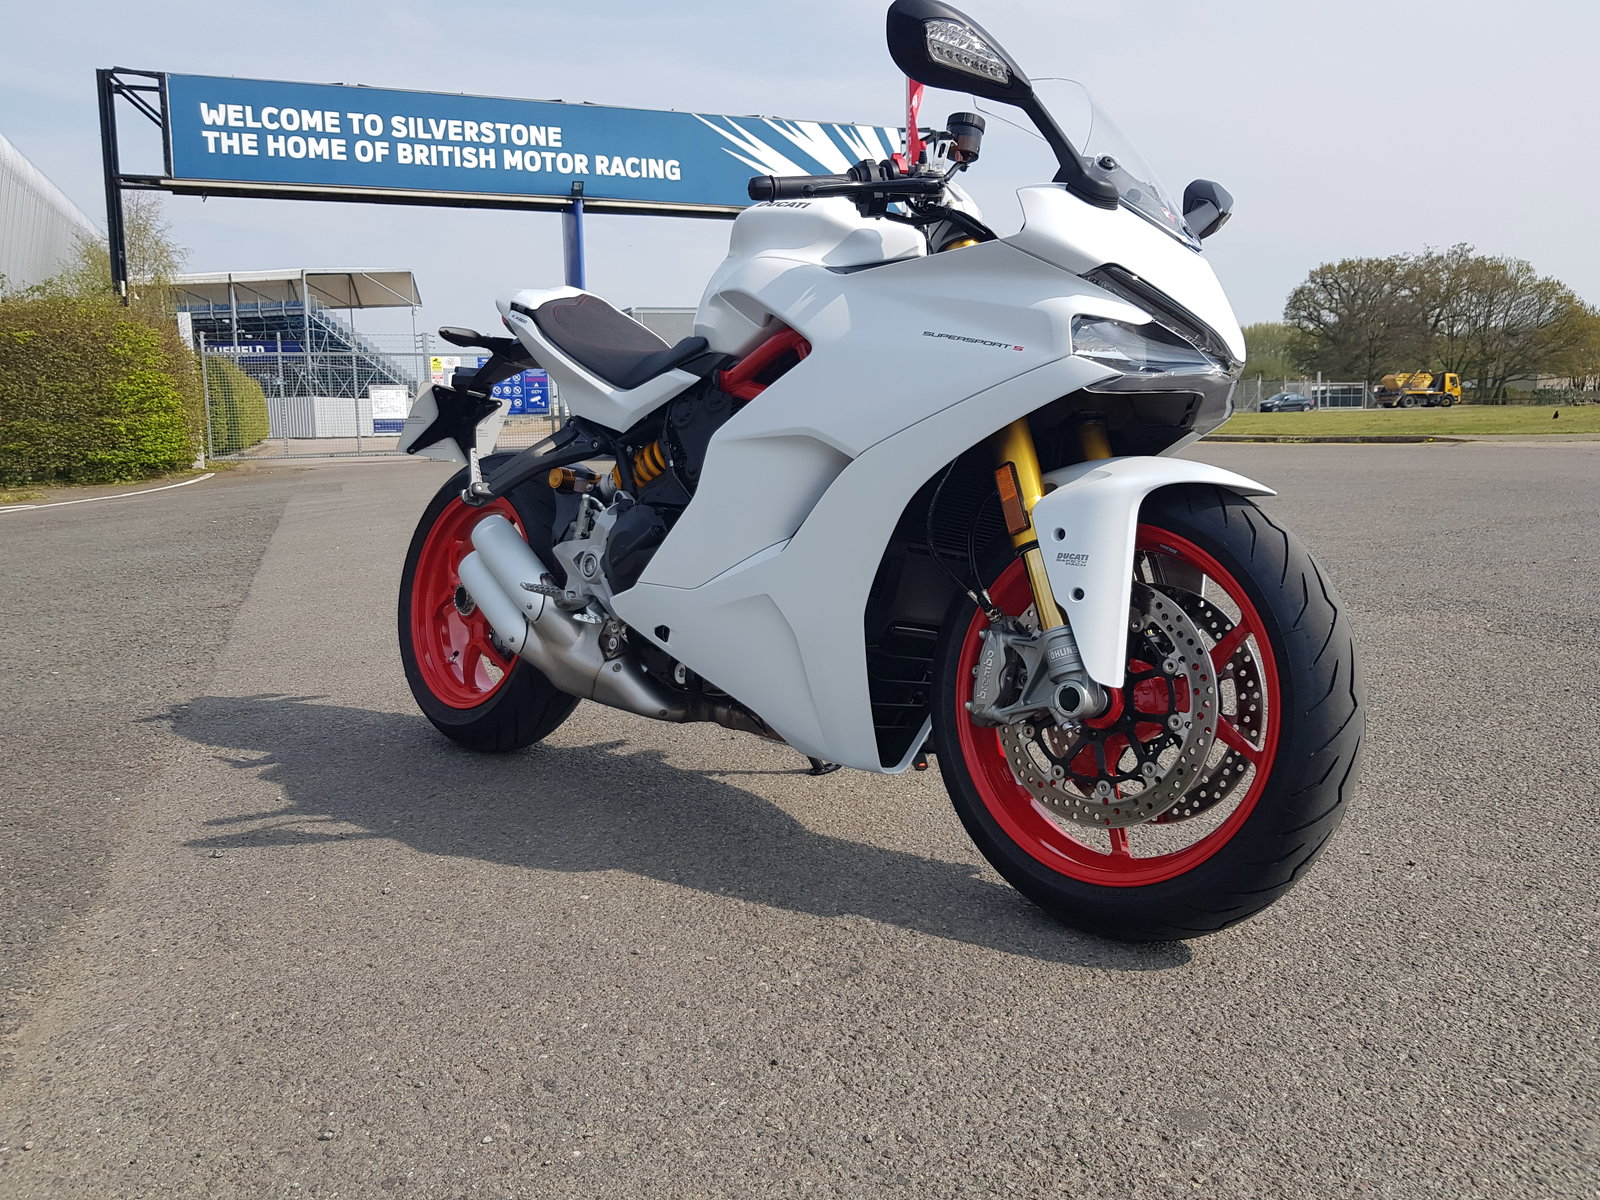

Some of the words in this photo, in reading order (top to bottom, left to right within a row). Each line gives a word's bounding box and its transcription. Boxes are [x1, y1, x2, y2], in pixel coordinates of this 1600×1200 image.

[200, 102, 341, 133] WELCOME
[347, 112, 384, 137] TO
[391, 115, 563, 148] SILVERSTONE
[202, 130, 259, 156] THE
[266, 134, 347, 161] HOME
[354, 140, 390, 163] OF
[397, 142, 497, 169] BRITISH
[503, 149, 590, 175] MOTOR
[595, 155, 682, 181] RACING
[757, 201, 812, 209] DUCATI
[922, 330, 1012, 349] SUPERSPORT
[1057, 552, 1089, 561] DUCATI
[977, 650, 995, 699] brembo
